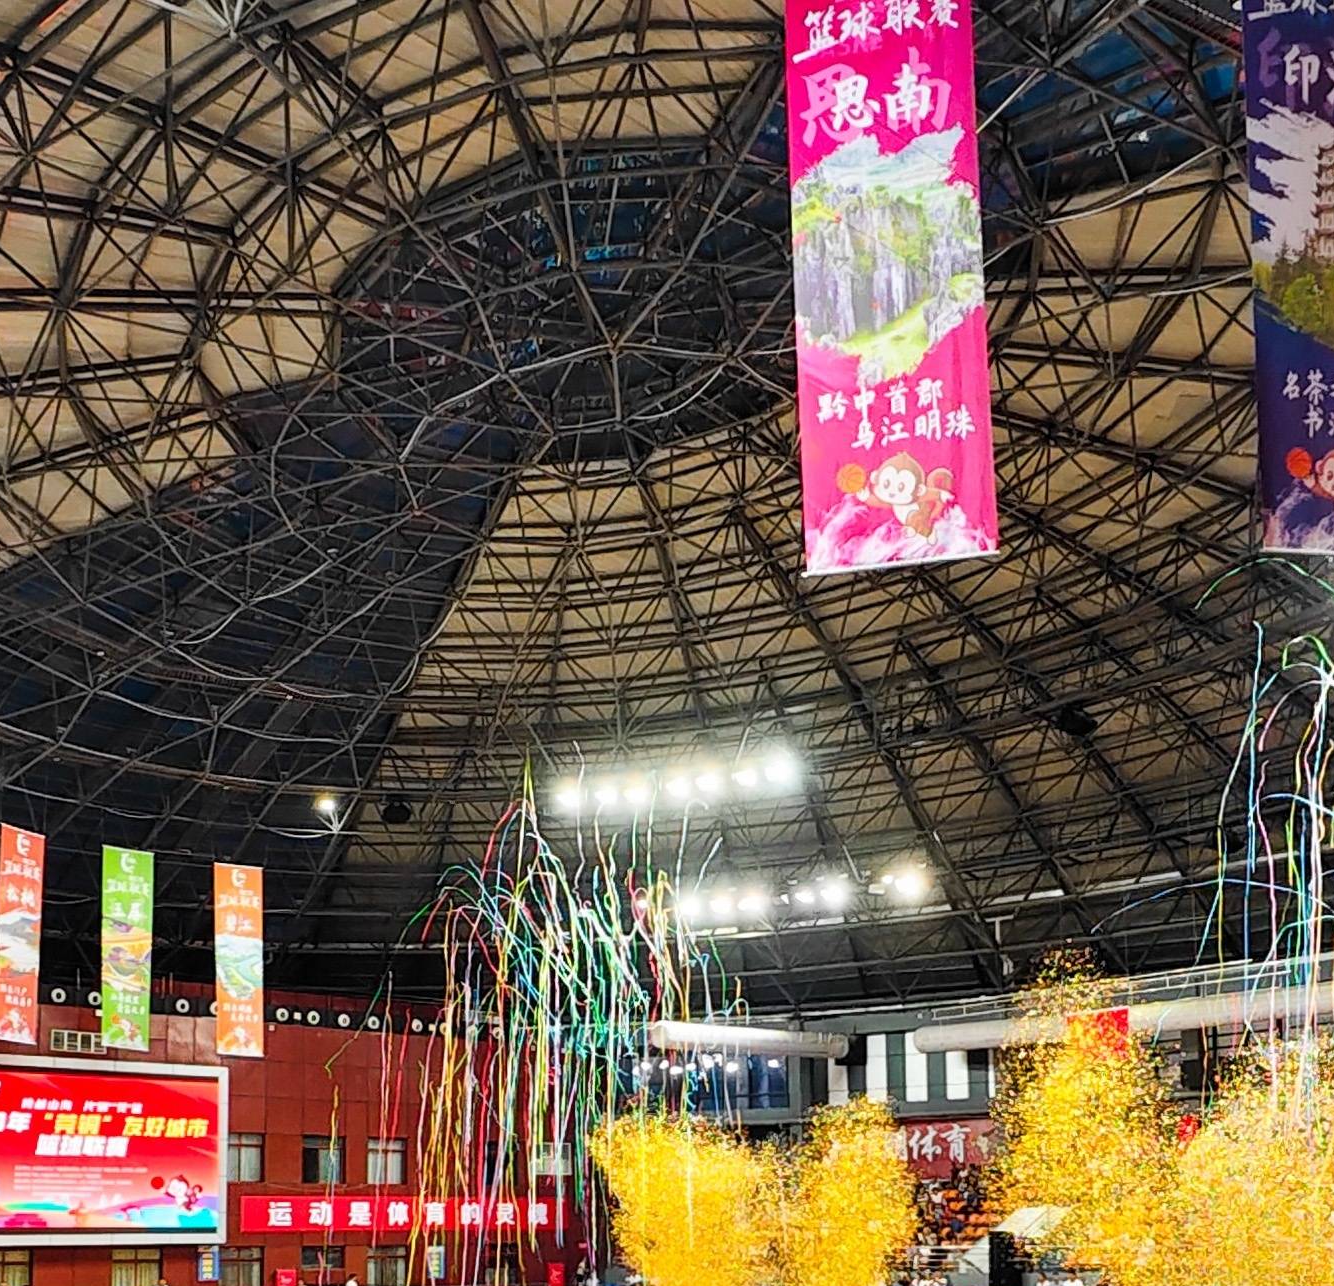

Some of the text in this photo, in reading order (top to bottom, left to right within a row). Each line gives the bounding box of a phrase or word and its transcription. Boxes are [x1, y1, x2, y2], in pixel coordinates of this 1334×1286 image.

[819, 57, 942, 137] 思南
[816, 377, 944, 424] 黔中首郡
[850, 403, 977, 450] 乌江明珠
